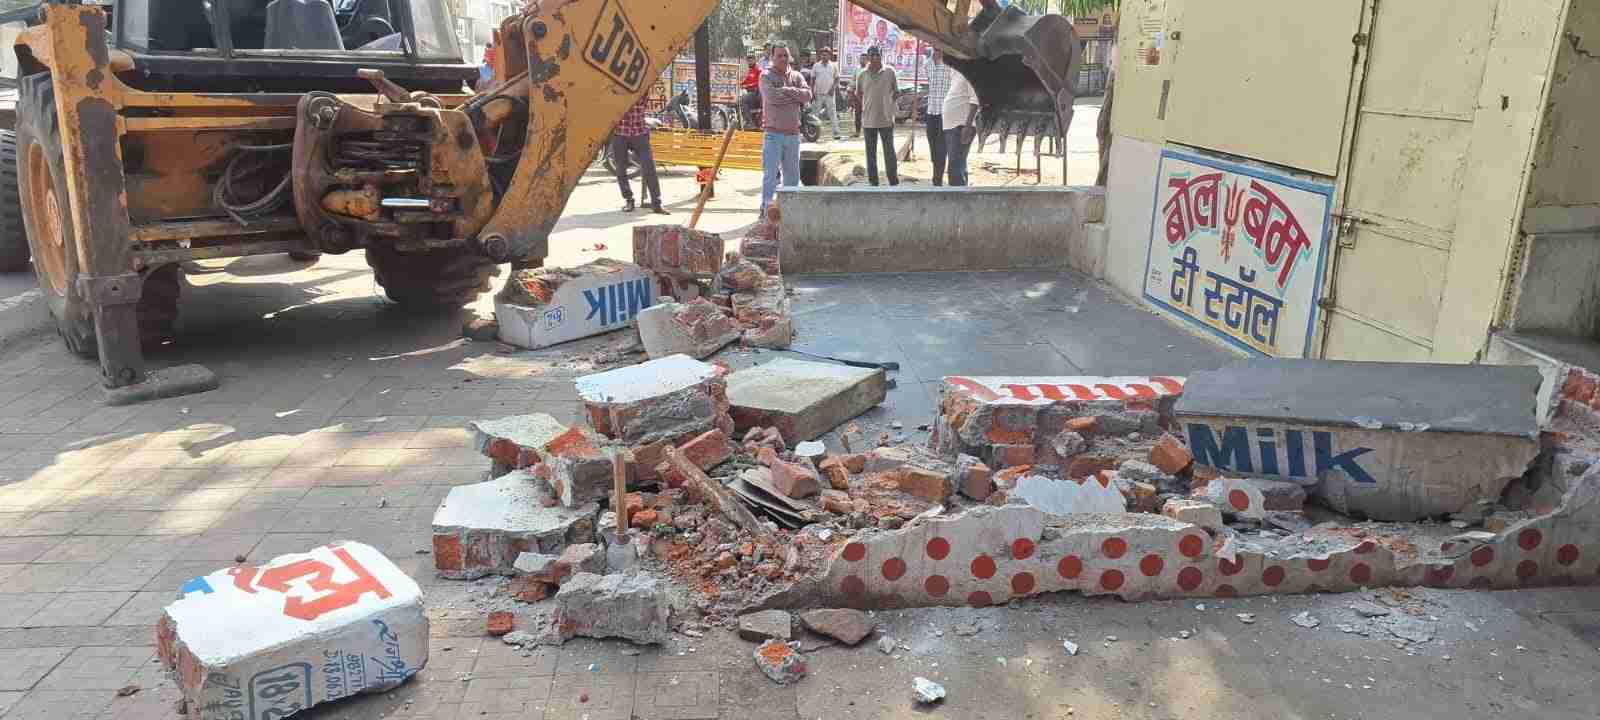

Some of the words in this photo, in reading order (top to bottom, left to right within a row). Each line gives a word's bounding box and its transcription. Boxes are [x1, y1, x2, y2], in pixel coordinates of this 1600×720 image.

[591, 13, 645, 87] JCB
[1162, 172, 1223, 244] बोल
[1244, 179, 1312, 288] बम
[583, 277, 650, 326] Milk
[1170, 246, 1200, 306] टी
[1204, 265, 1284, 346] स्टॉल
[1188, 423, 1377, 484] Milk
